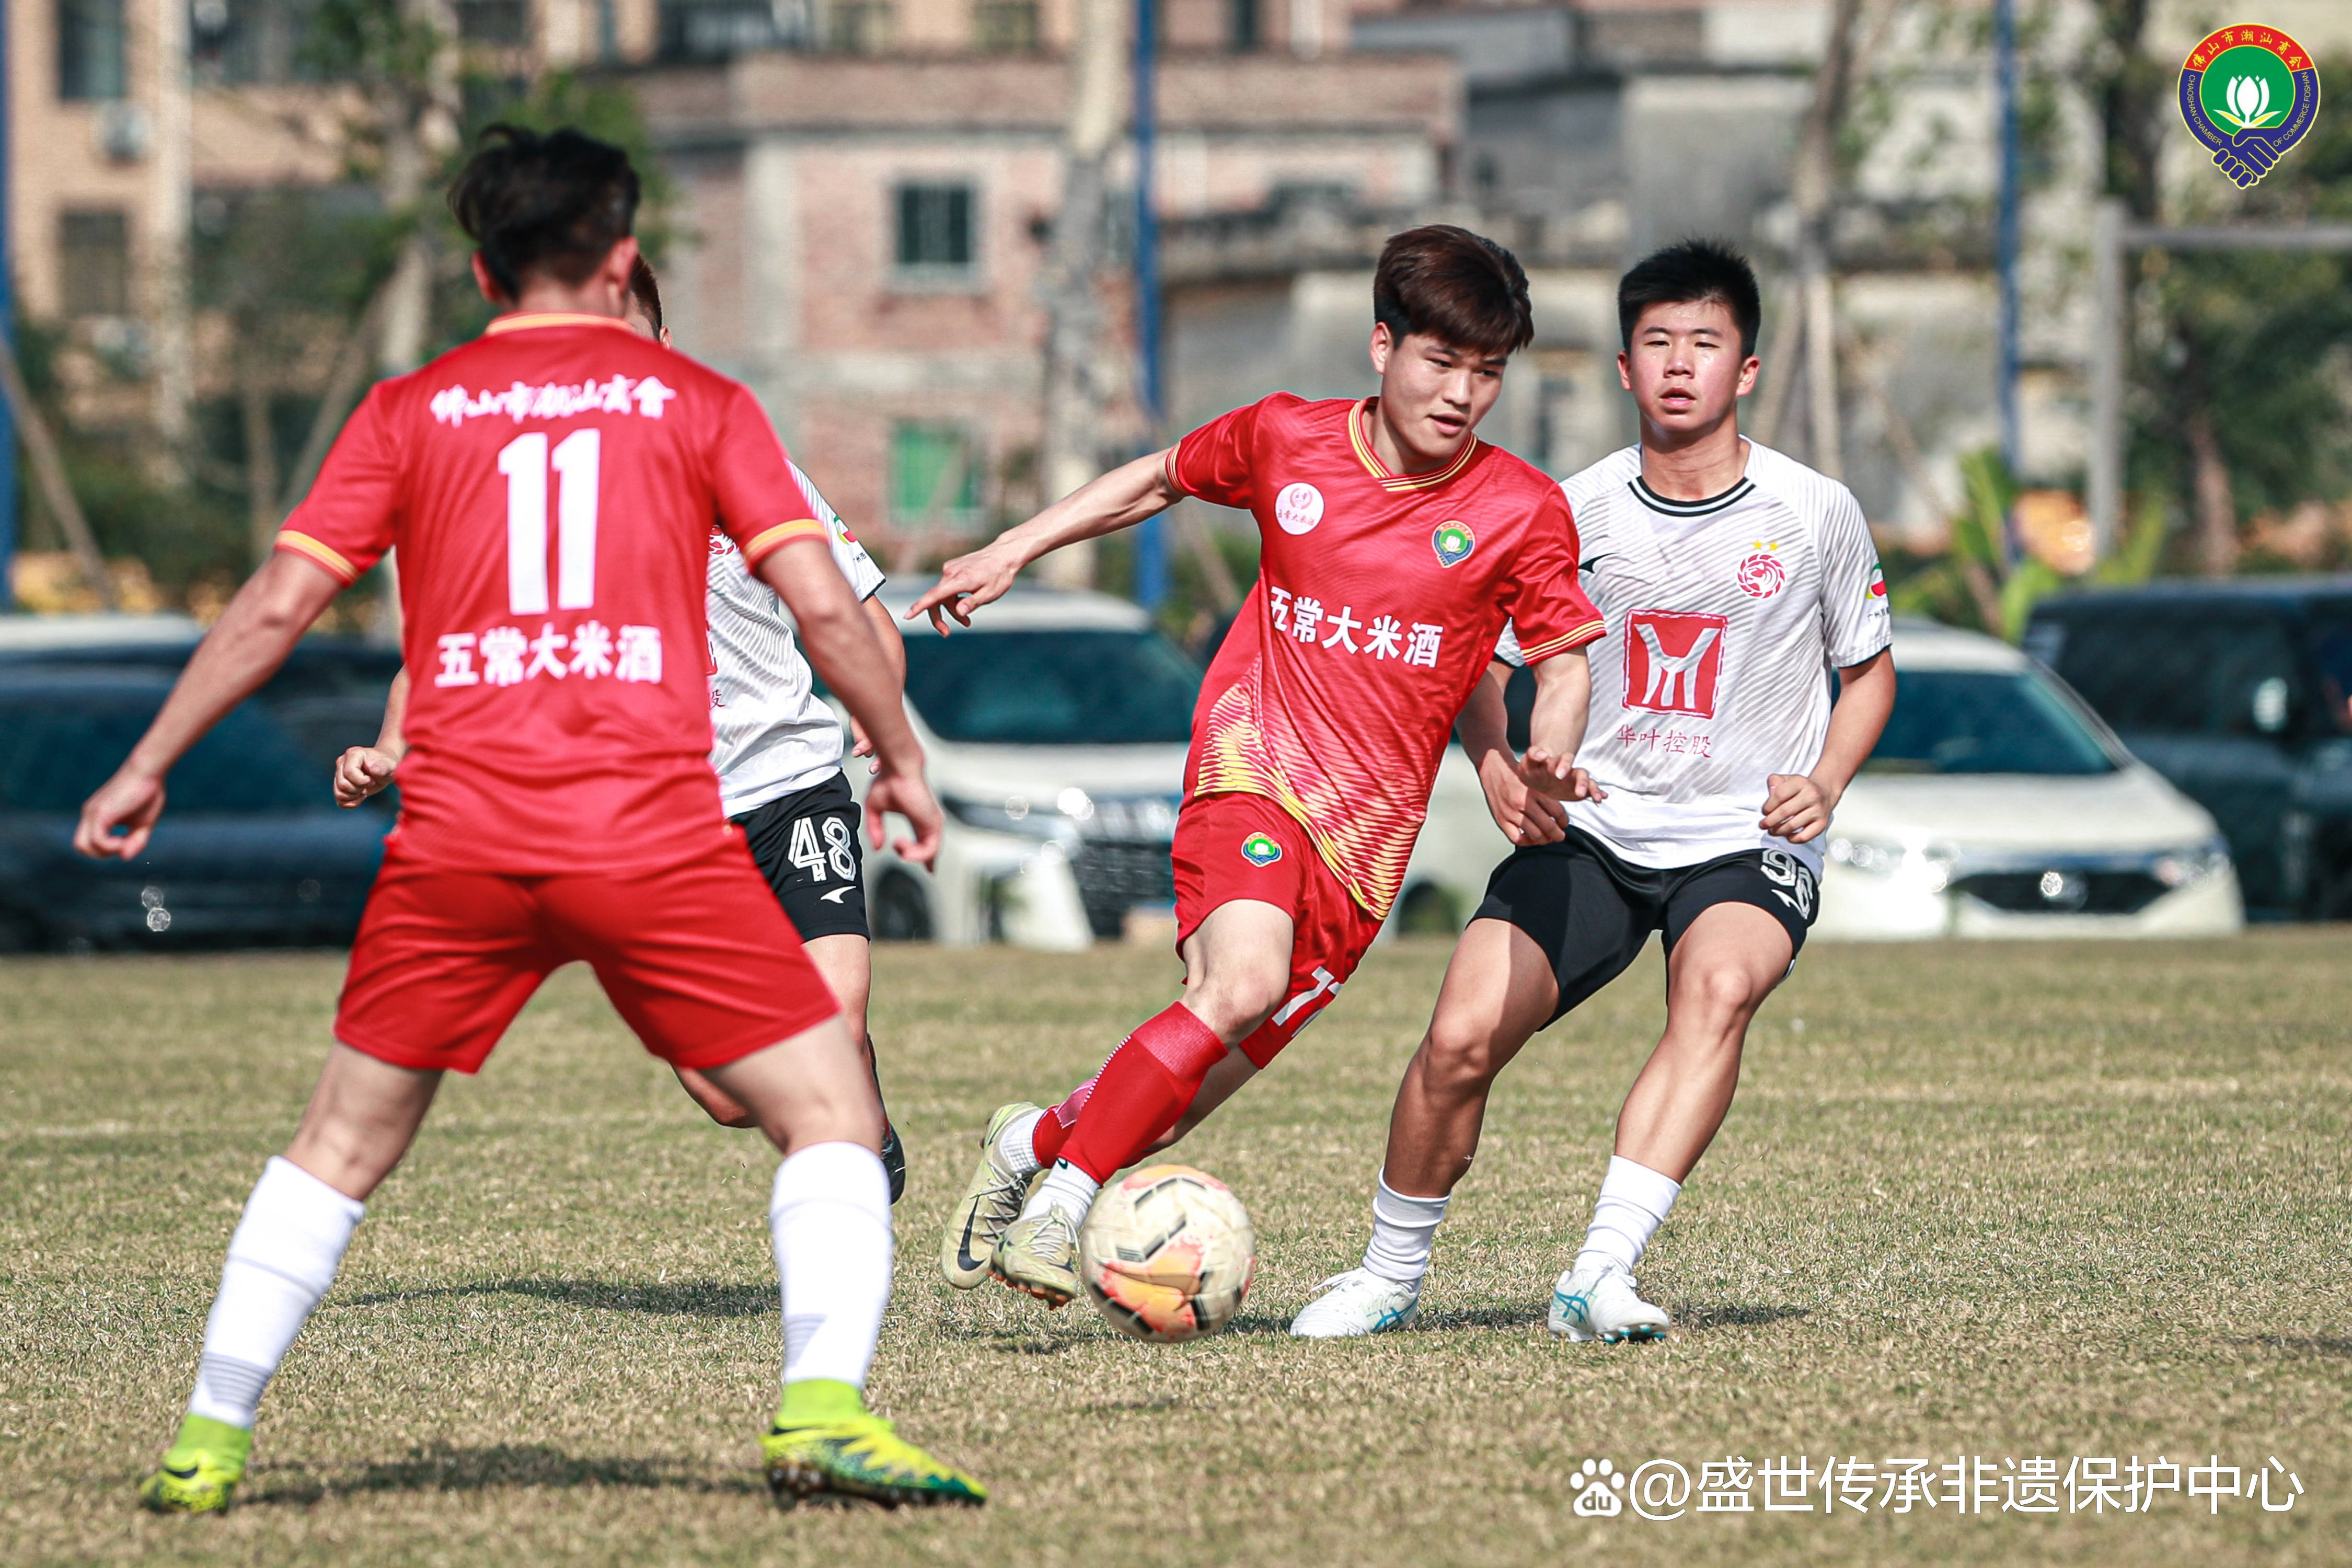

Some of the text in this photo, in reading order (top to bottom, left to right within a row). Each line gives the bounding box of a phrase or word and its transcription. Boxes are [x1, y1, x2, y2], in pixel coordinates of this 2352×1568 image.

[498, 428, 601, 616] 11
[434, 620, 663, 687] 五常大米酒
[1270, 586, 1444, 667] 五常大米酒
[1616, 724, 1712, 758] 华叶控股
[788, 816, 857, 882] 48
